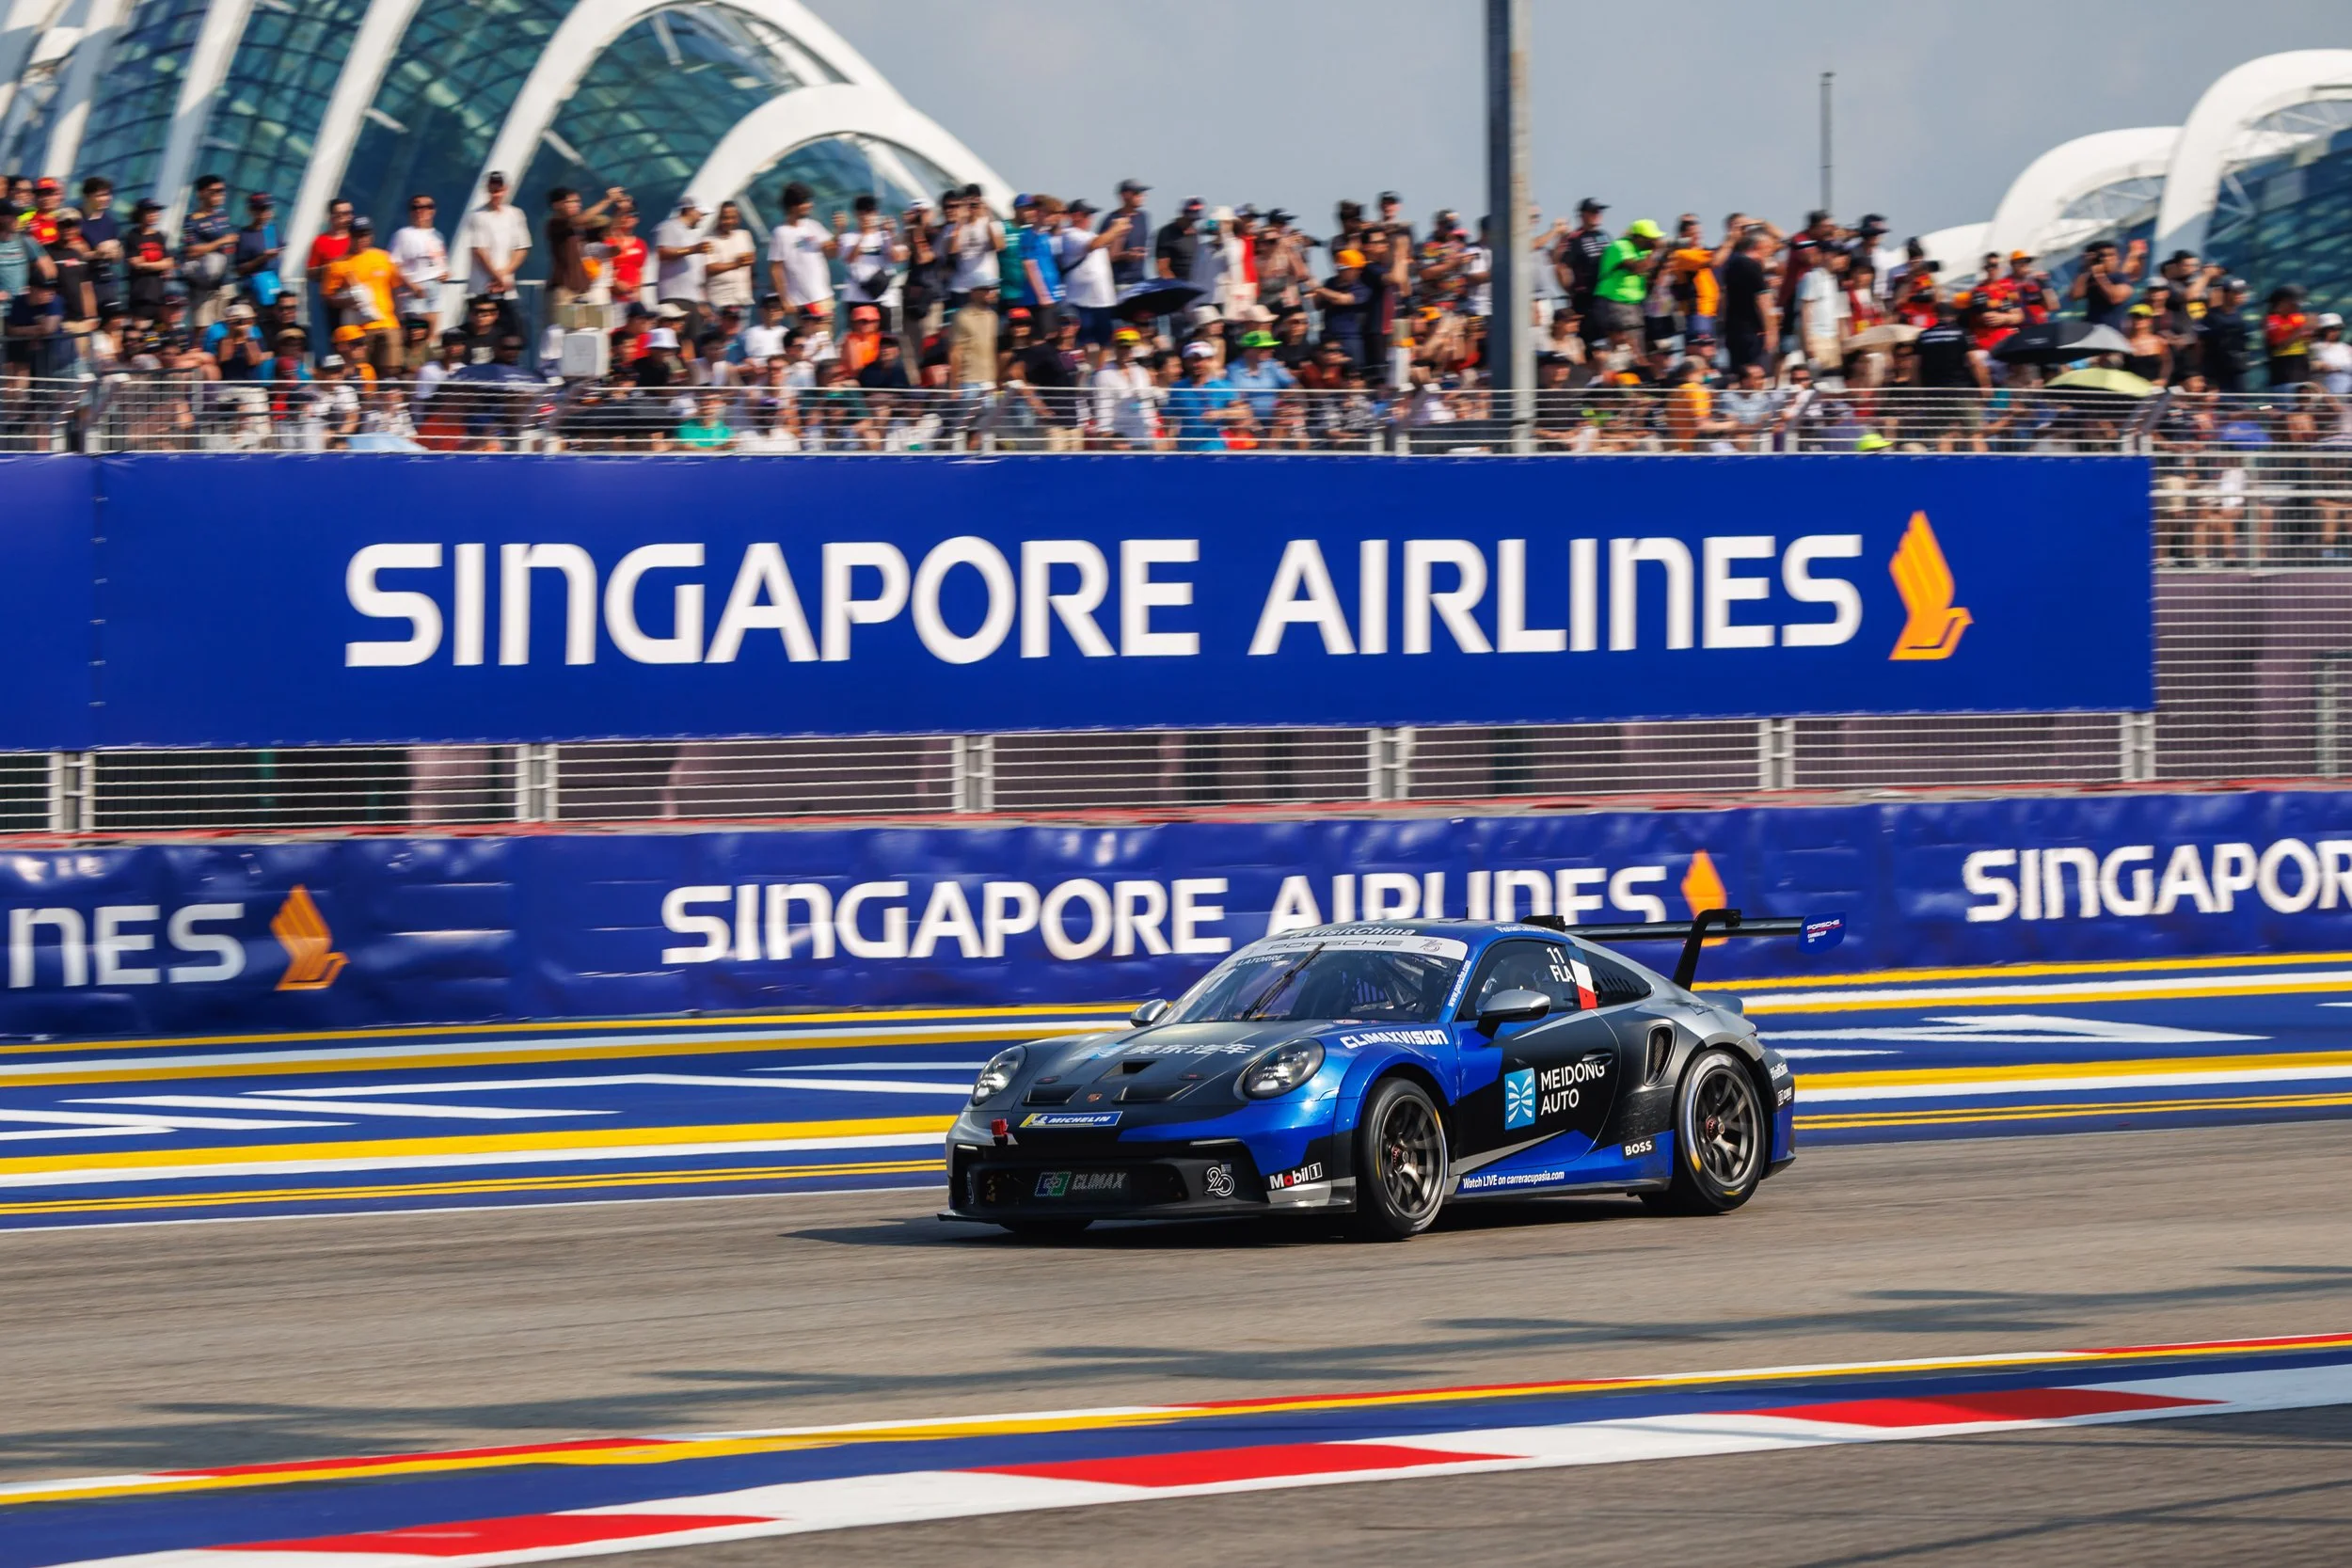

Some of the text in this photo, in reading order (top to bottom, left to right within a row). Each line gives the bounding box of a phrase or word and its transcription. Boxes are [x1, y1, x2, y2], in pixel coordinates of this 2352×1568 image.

[345, 534, 1863, 666] SINGAPORE AIRLINES
[661, 878, 1232, 964] SINGAPORE
[1290, 927, 1415, 939] #VisitChina
[1546, 946, 1565, 964] 11
[1549, 965, 1575, 983] FLA
[1340, 1029, 1449, 1050] CLIMAXVISION
[1540, 1062, 1605, 1092] MEIDONG
[1540, 1088, 1580, 1116] AUTO
[1048, 1116, 1111, 1124] MICHELIN
[1625, 1140, 1652, 1156] BOSS
[1072, 1173, 1127, 1191] CLIMAX
[1269, 1166, 1309, 1189] Mobil
[1463, 1177, 1482, 1189] Watch
[1483, 1174, 1497, 1187] LIVE
[1507, 1170, 1565, 1185] carreracupasia.com
